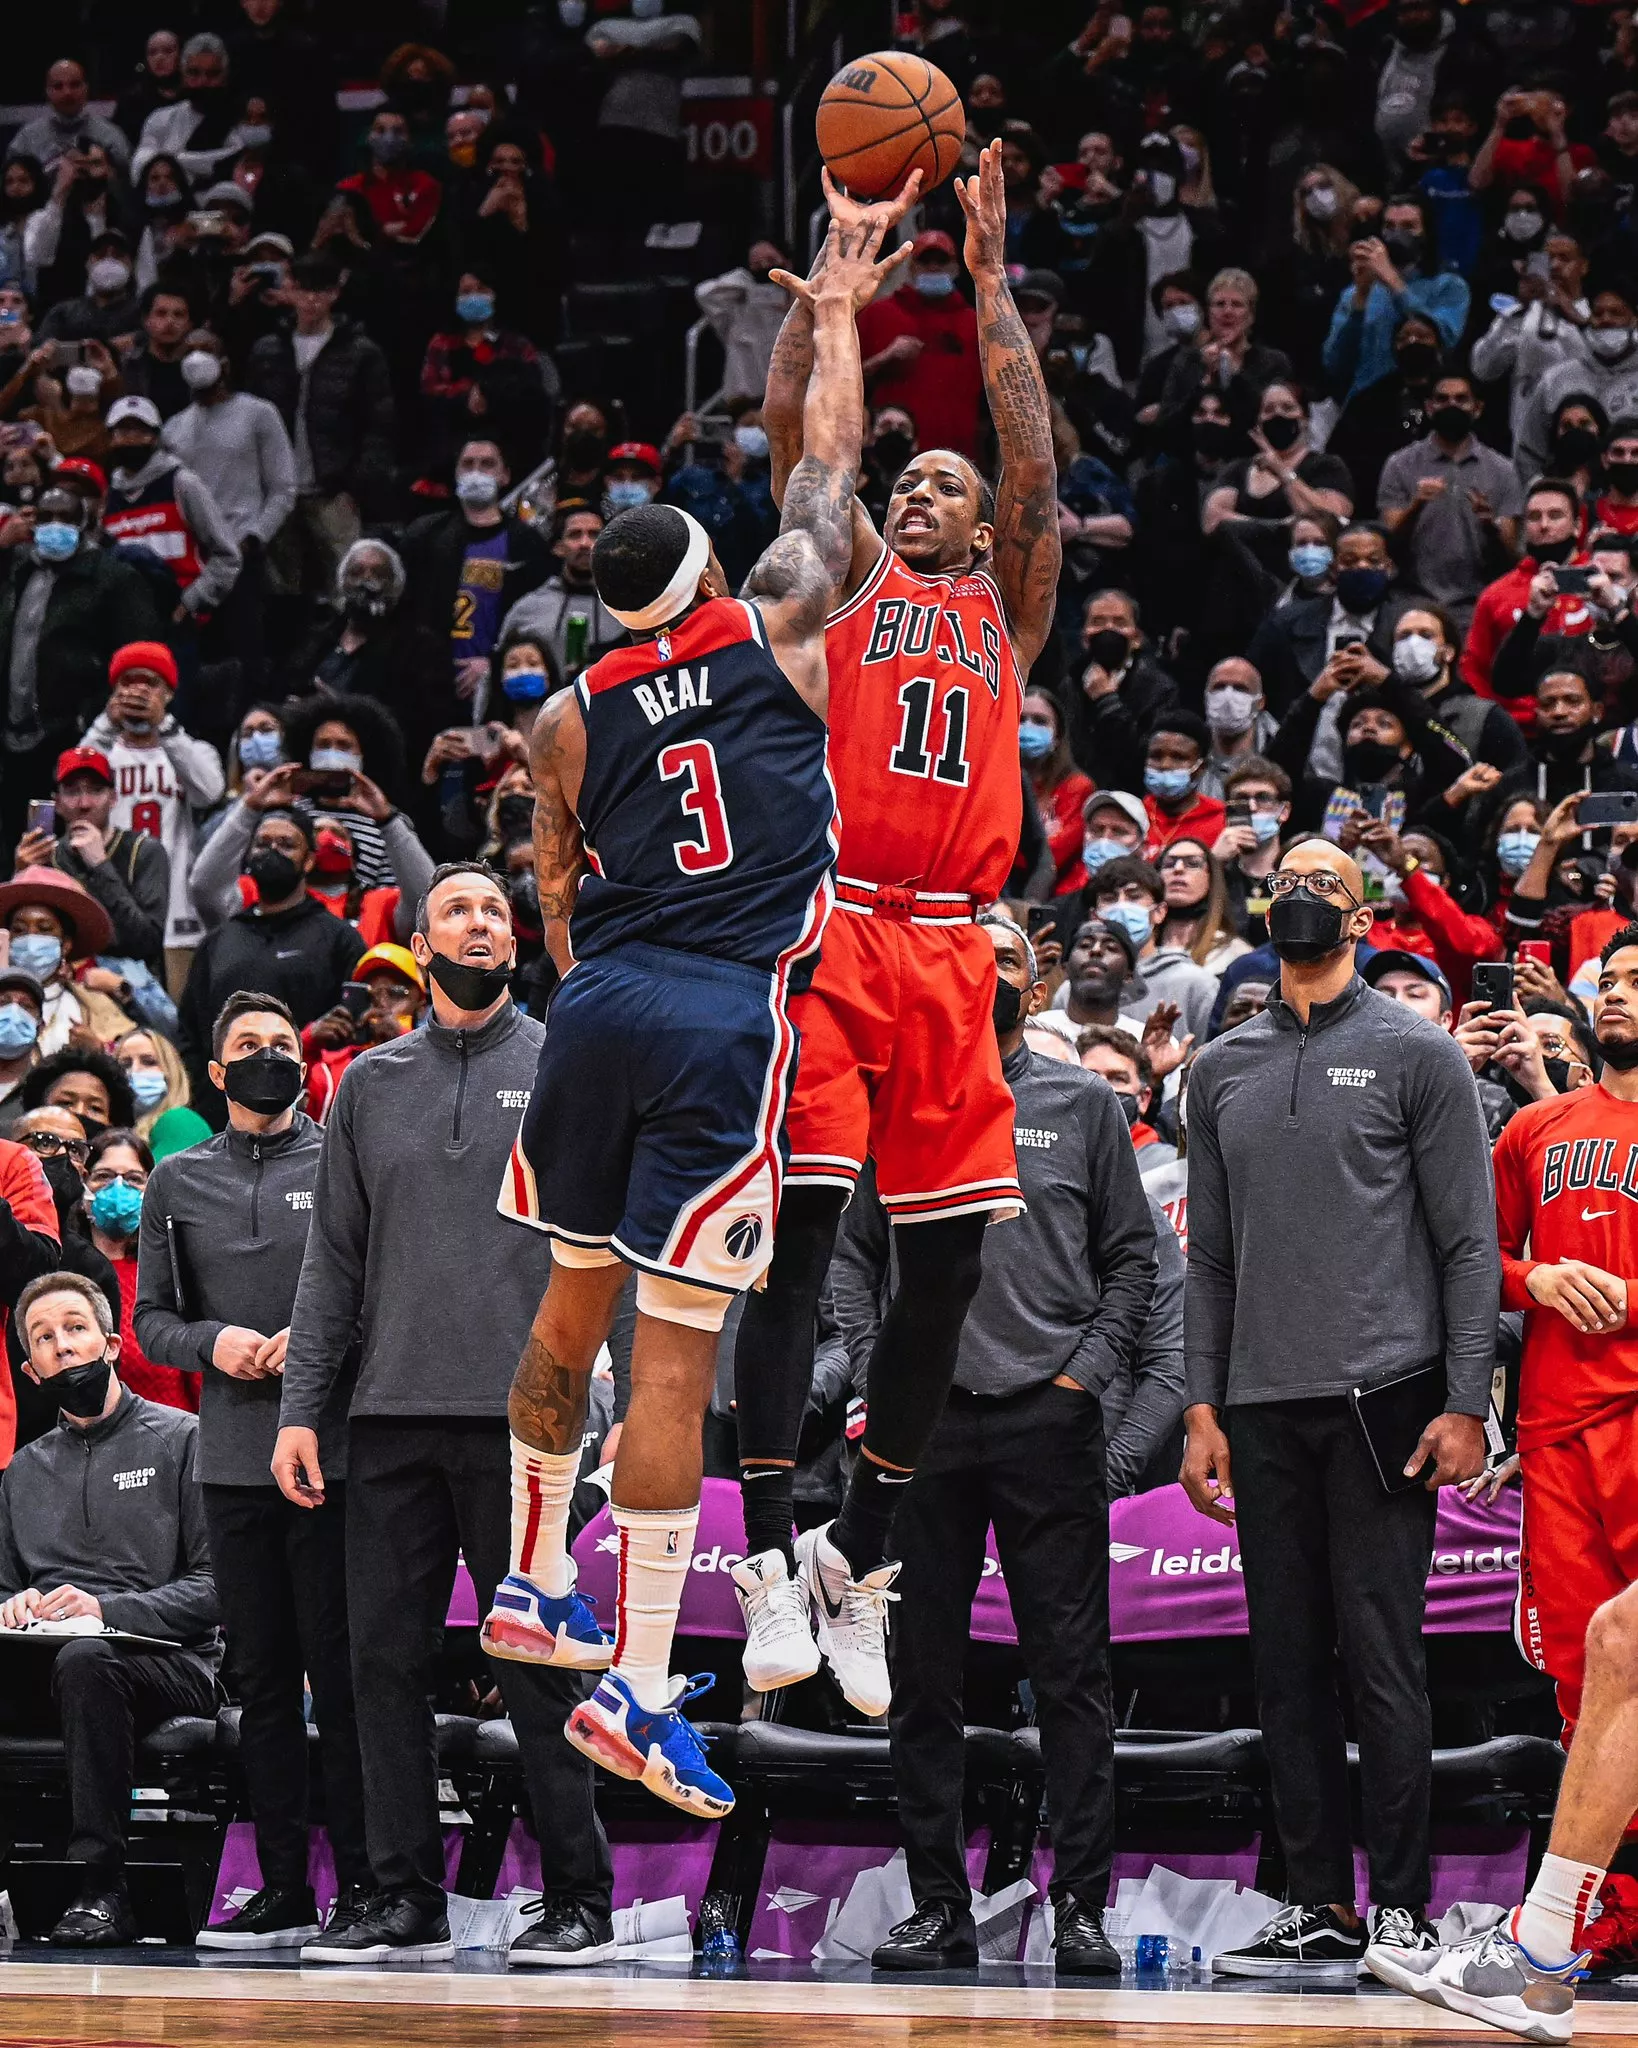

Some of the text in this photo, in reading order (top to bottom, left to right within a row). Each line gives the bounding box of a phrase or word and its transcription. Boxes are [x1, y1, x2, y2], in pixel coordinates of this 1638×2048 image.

[684, 119, 758, 162] 100
[861, 597, 1001, 701] BULS
[632, 666, 713, 726] BEAL
[888, 675, 970, 788] 11
[120, 764, 185, 801] ULL
[657, 738, 734, 876] 3
[1326, 1067, 1377, 1080] CHICAGO
[1331, 1076, 1367, 1088] BULLS
[496, 1090, 531, 1100] CHICA
[1013, 1127, 1059, 1142] HICAGO
[1015, 1136, 1051, 1149] BULLS
[1541, 1138, 1638, 1206] BULL
[285, 1191, 314, 1202] CHIC
[292, 1200, 313, 1210] BUL
[112, 1467, 156, 1483] CHICAGO
[118, 1477, 149, 1491] BULLS
[1150, 1545, 1244, 1577] leid
[1428, 1546, 1520, 1575] eido
[1527, 1606, 1546, 1672] BULLS
